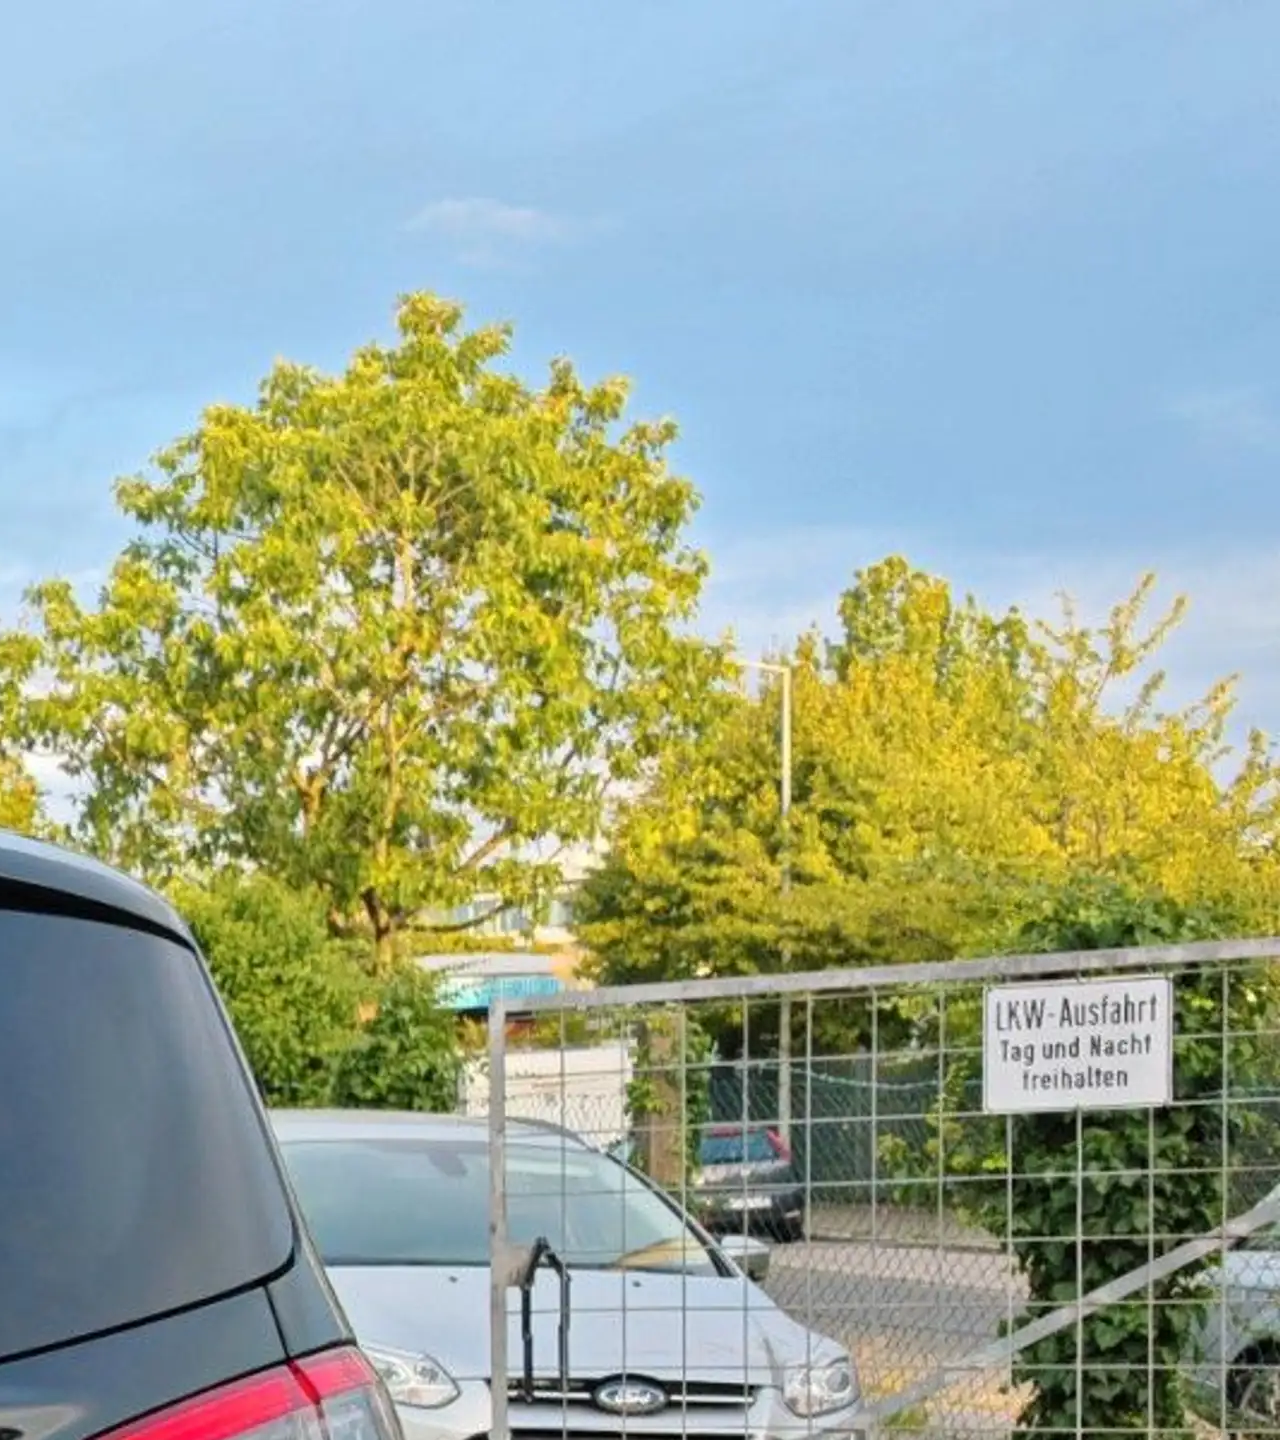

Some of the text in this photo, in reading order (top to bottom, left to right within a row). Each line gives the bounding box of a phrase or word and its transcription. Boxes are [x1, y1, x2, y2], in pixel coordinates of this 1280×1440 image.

[995, 993, 1158, 1031] LKW-Ausfahrt
[1000, 1034, 1152, 1066] Tag und Nacht
[1023, 1067, 1128, 1090] freihalten
